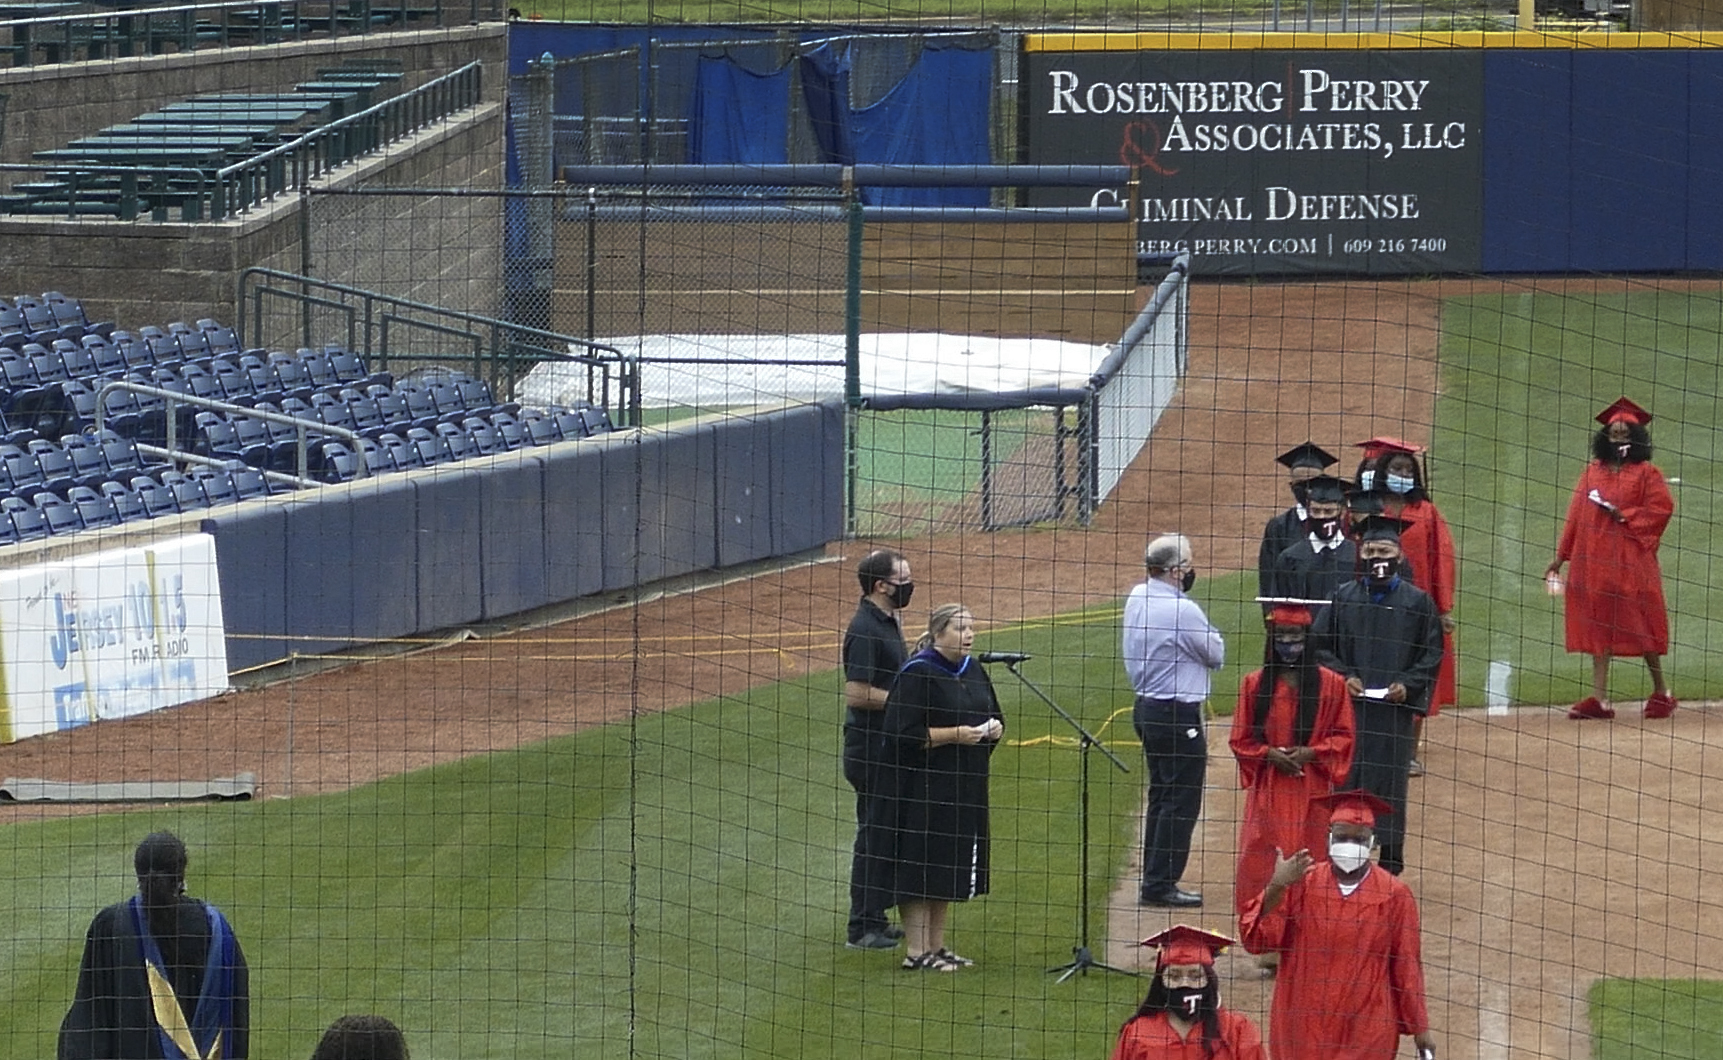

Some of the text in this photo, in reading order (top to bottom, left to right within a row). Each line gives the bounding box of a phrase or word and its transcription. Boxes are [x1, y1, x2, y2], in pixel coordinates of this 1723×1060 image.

[1047, 68, 1430, 114] ROSENBERG PERRY
[1119, 114, 1466, 176] & ASSOCIATES, LLC
[1265, 186, 1420, 221] DEFENSE
[1343, 238, 1373, 254] 609
[1378, 238, 1405, 253] 216
[1410, 237, 1447, 253] 7400
[131, 645, 150, 666] FM
